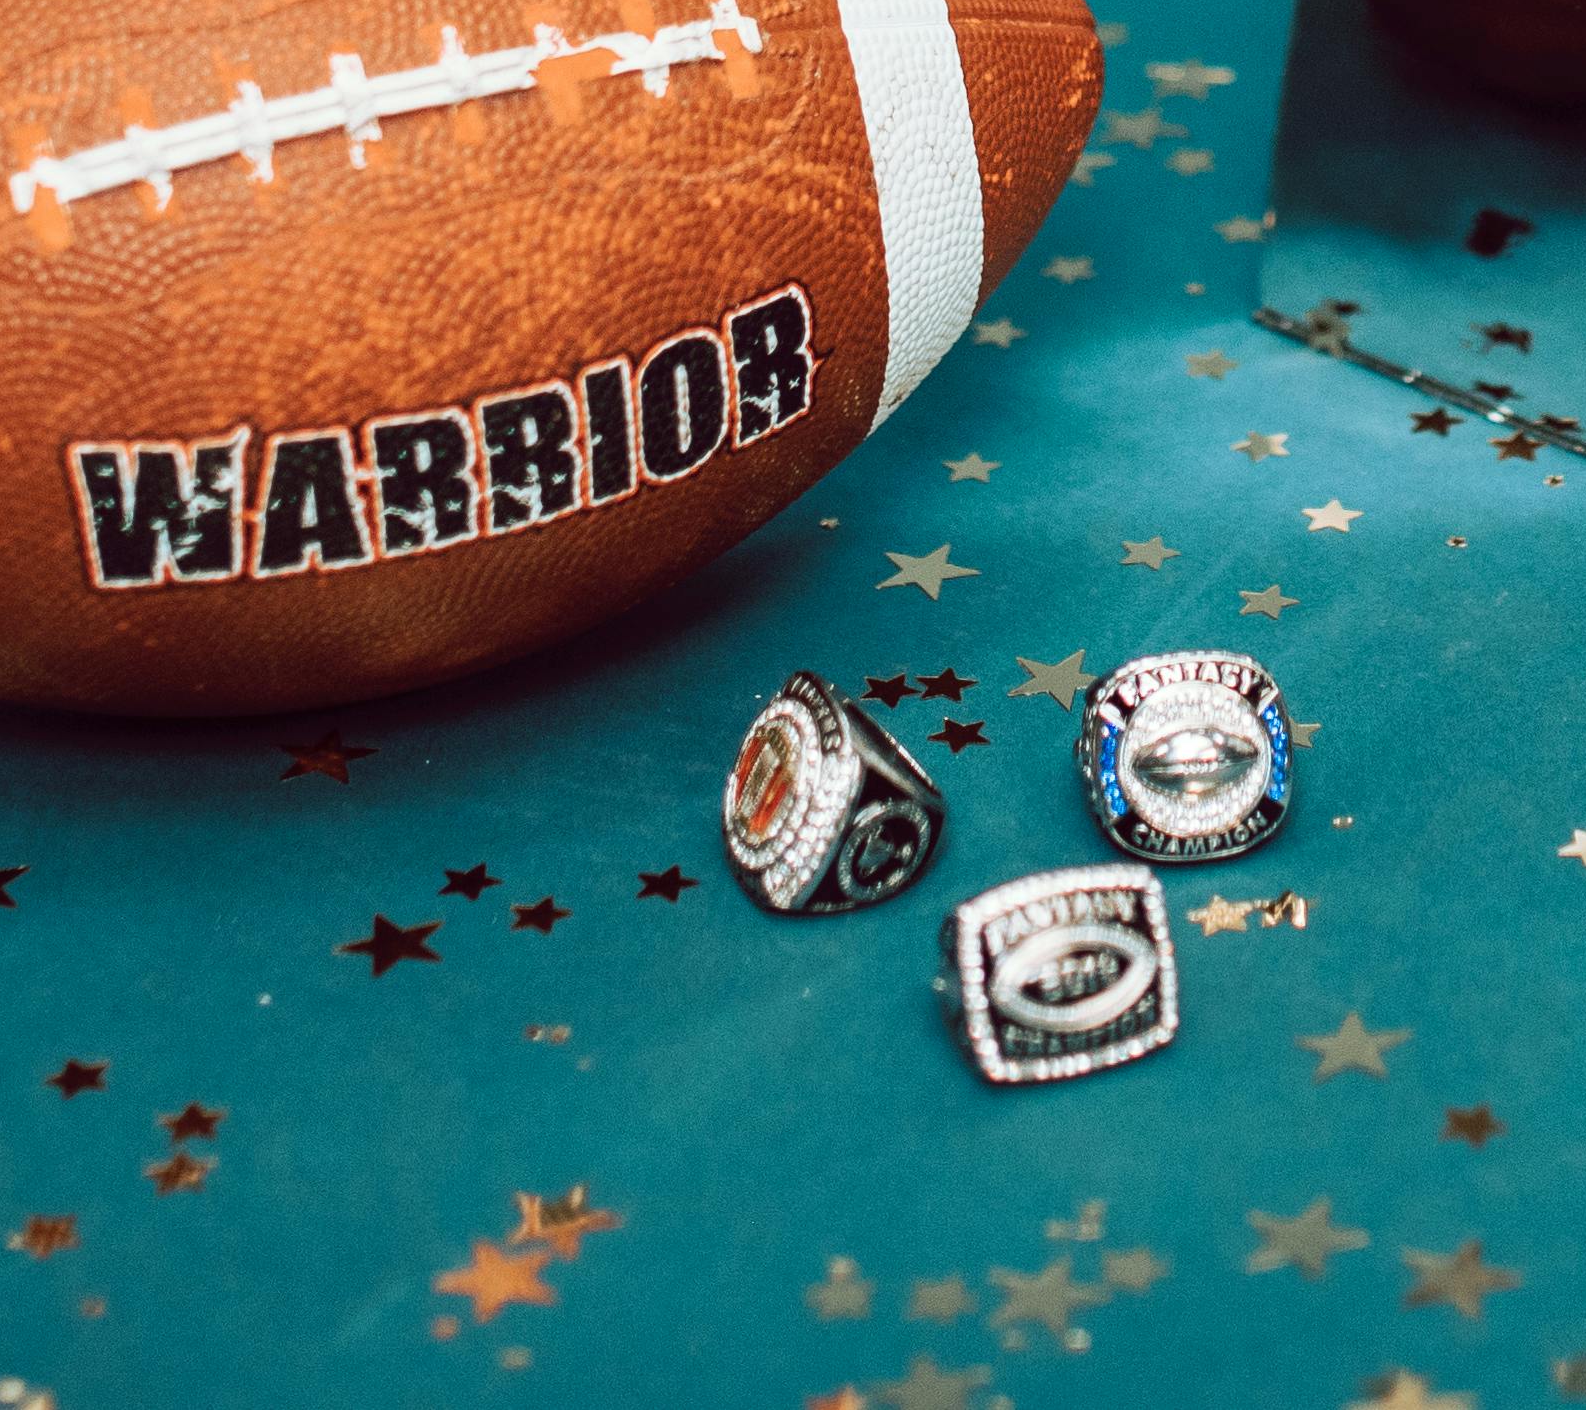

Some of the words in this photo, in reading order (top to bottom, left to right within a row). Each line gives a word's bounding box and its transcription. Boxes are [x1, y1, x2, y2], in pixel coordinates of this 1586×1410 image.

[67, 281, 816, 590] WARRIOR
[1118, 661, 1270, 708] FANTASY
[1131, 810, 1268, 855] CHAMPION
